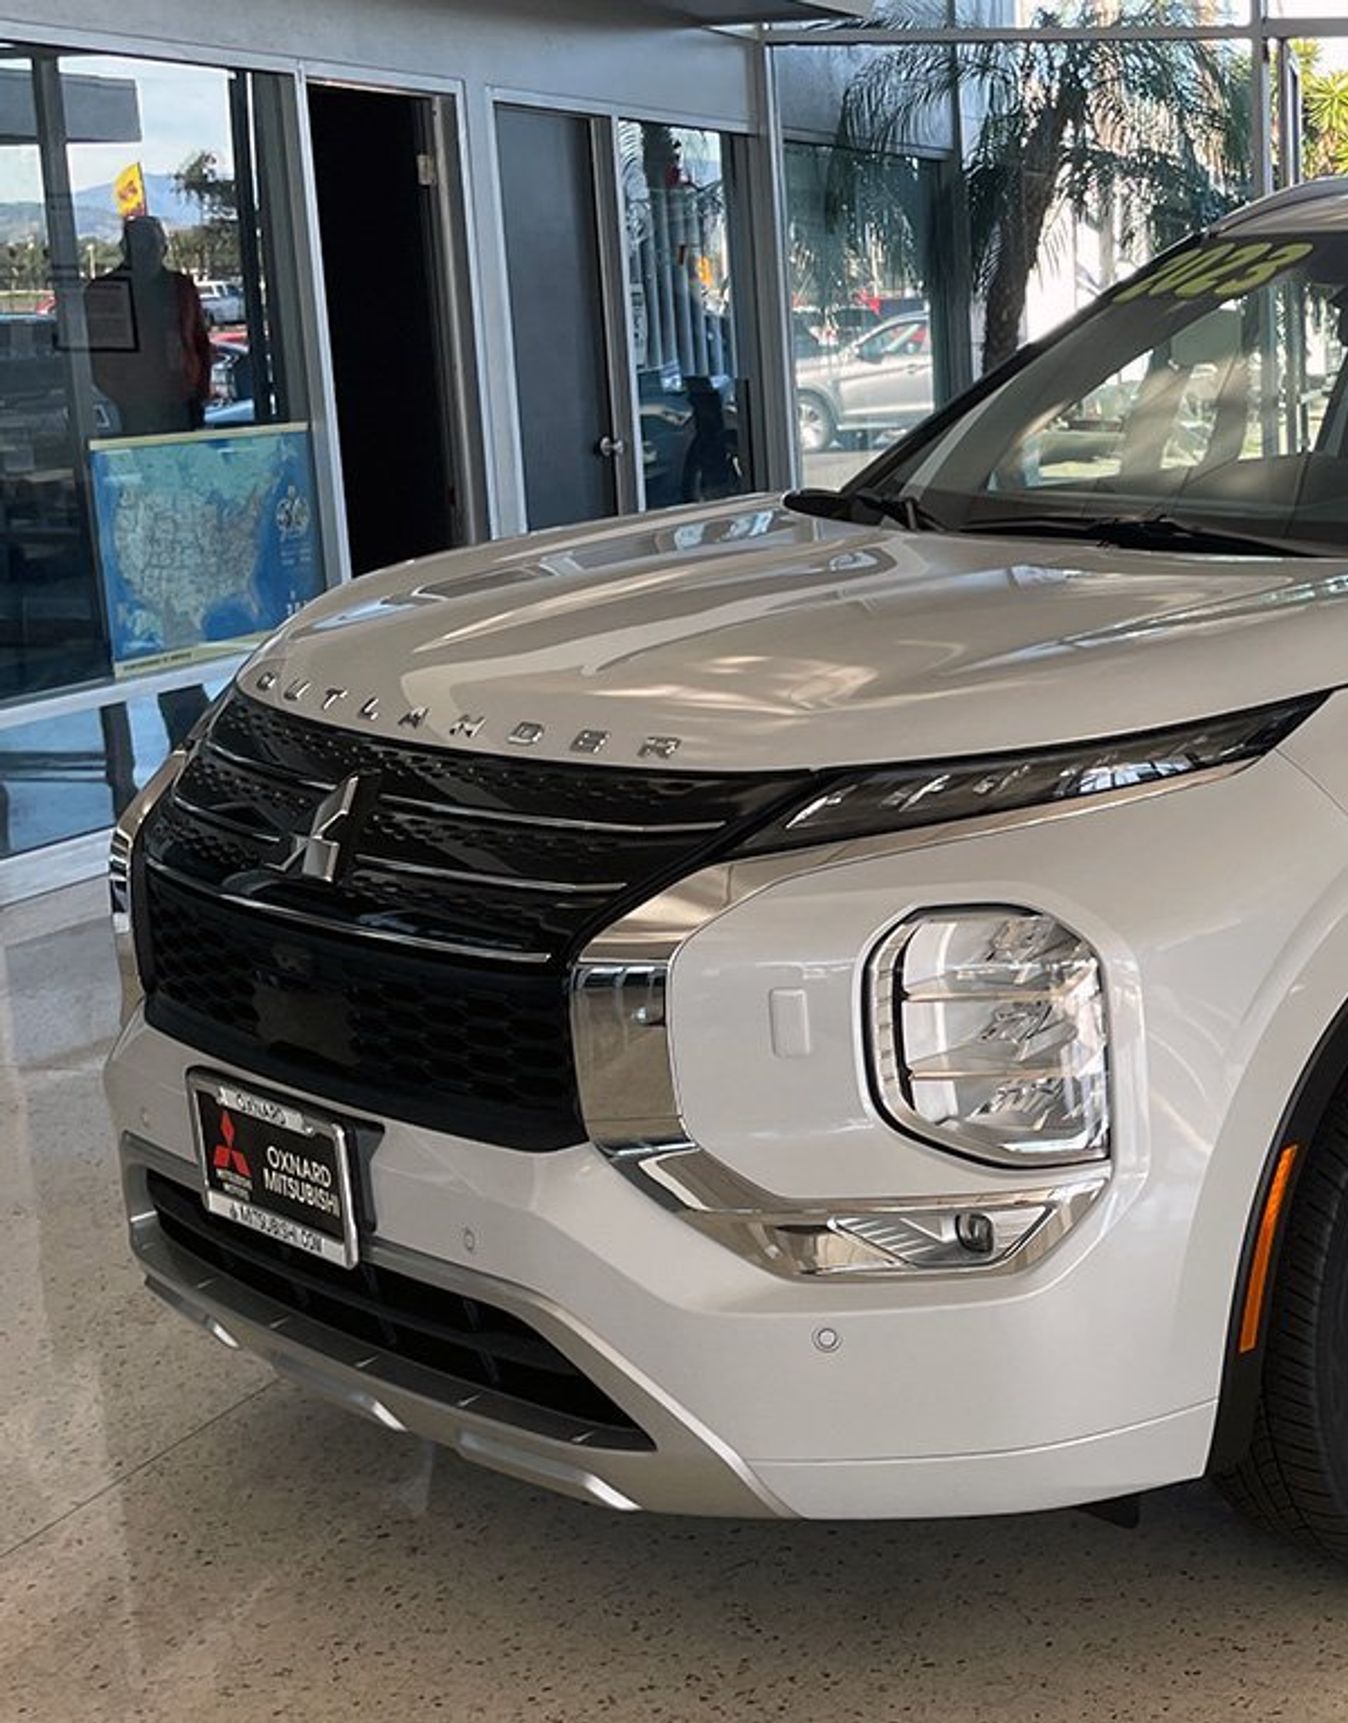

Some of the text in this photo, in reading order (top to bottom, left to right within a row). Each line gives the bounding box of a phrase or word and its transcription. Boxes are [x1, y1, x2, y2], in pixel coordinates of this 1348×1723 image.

[1112, 242, 1314, 304] 2023
[255, 671, 683, 760] OUTLANDER
[263, 1167, 342, 1219] MITSUBISHI
[266, 1145, 332, 1188] OXNARD
